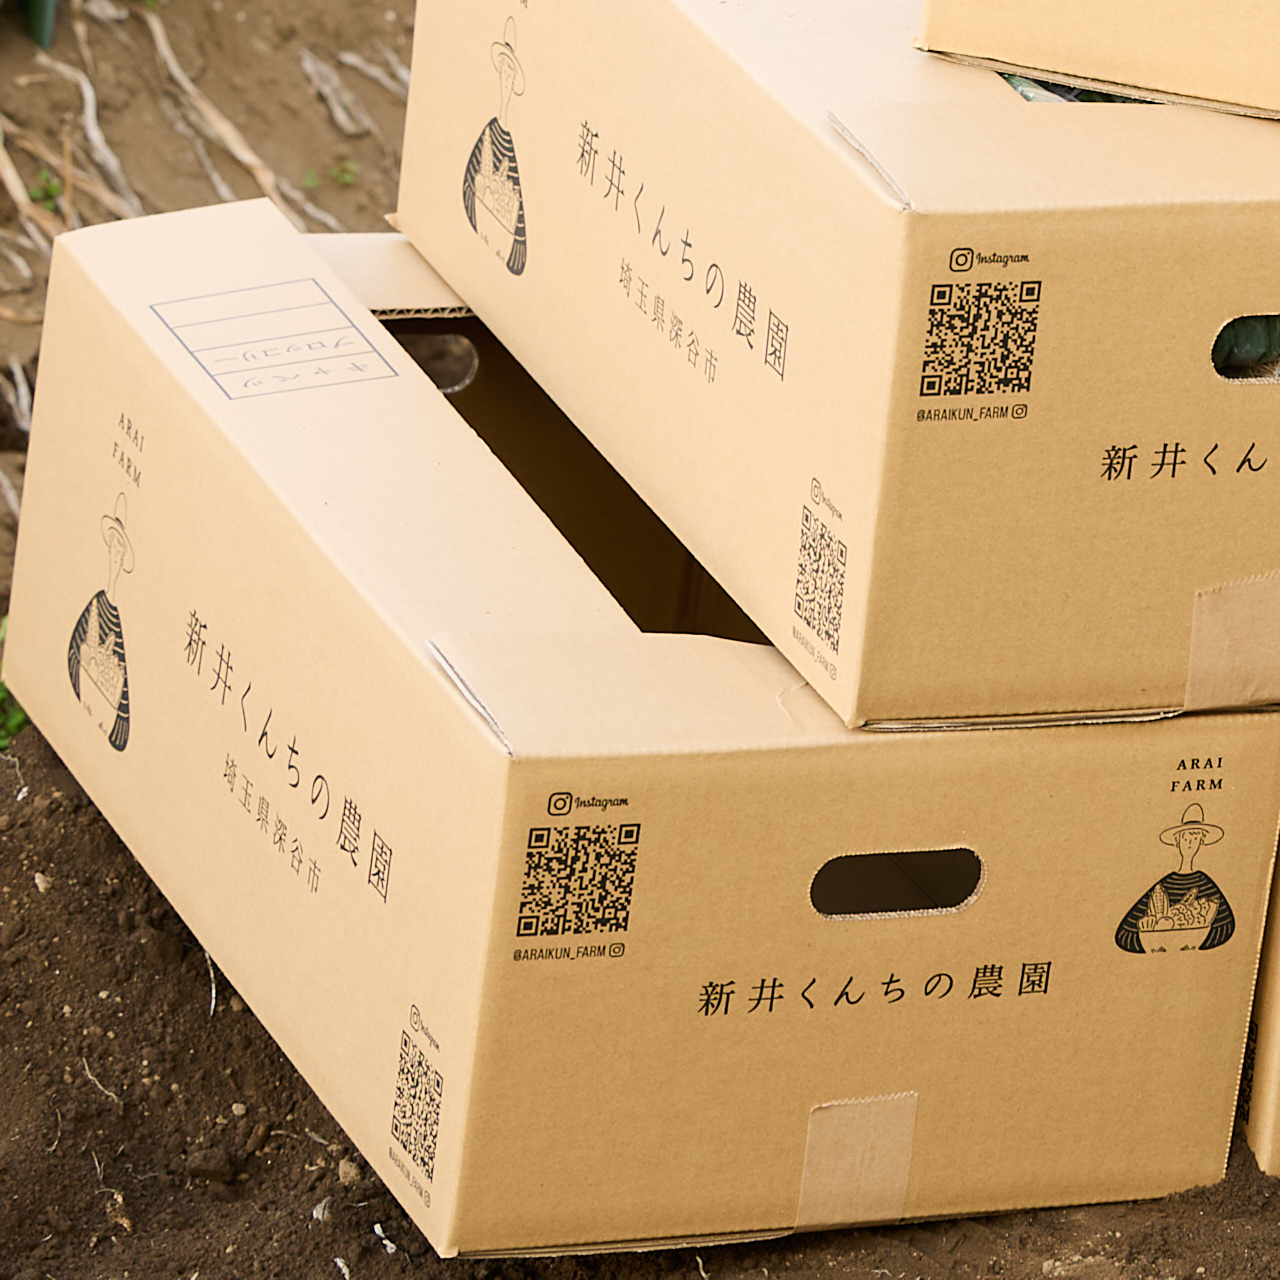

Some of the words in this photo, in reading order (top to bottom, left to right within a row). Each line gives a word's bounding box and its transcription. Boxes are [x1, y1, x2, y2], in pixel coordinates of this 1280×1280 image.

[576, 120, 790, 383] 新井くんちの農園
[975, 251, 1031, 269] Instagram
[617, 256, 720, 385] 埼玉県深谷市
[116, 410, 146, 454] ARAI
[915, 404, 1010, 423] @ARAIKUN_FARM
[111, 439, 143, 489] FARM
[183, 609, 394, 904] 新井くんちの農園
[1175, 756, 1223, 771] ARAI
[573, 795, 630, 813] Instagram
[1170, 777, 1224, 793] FARM
[222, 751, 323, 894] 埼玉県深谷市
[513, 943, 607, 962] @ARAIKUN_FARM
[697, 960, 1053, 1017] 新井くんちの農園
